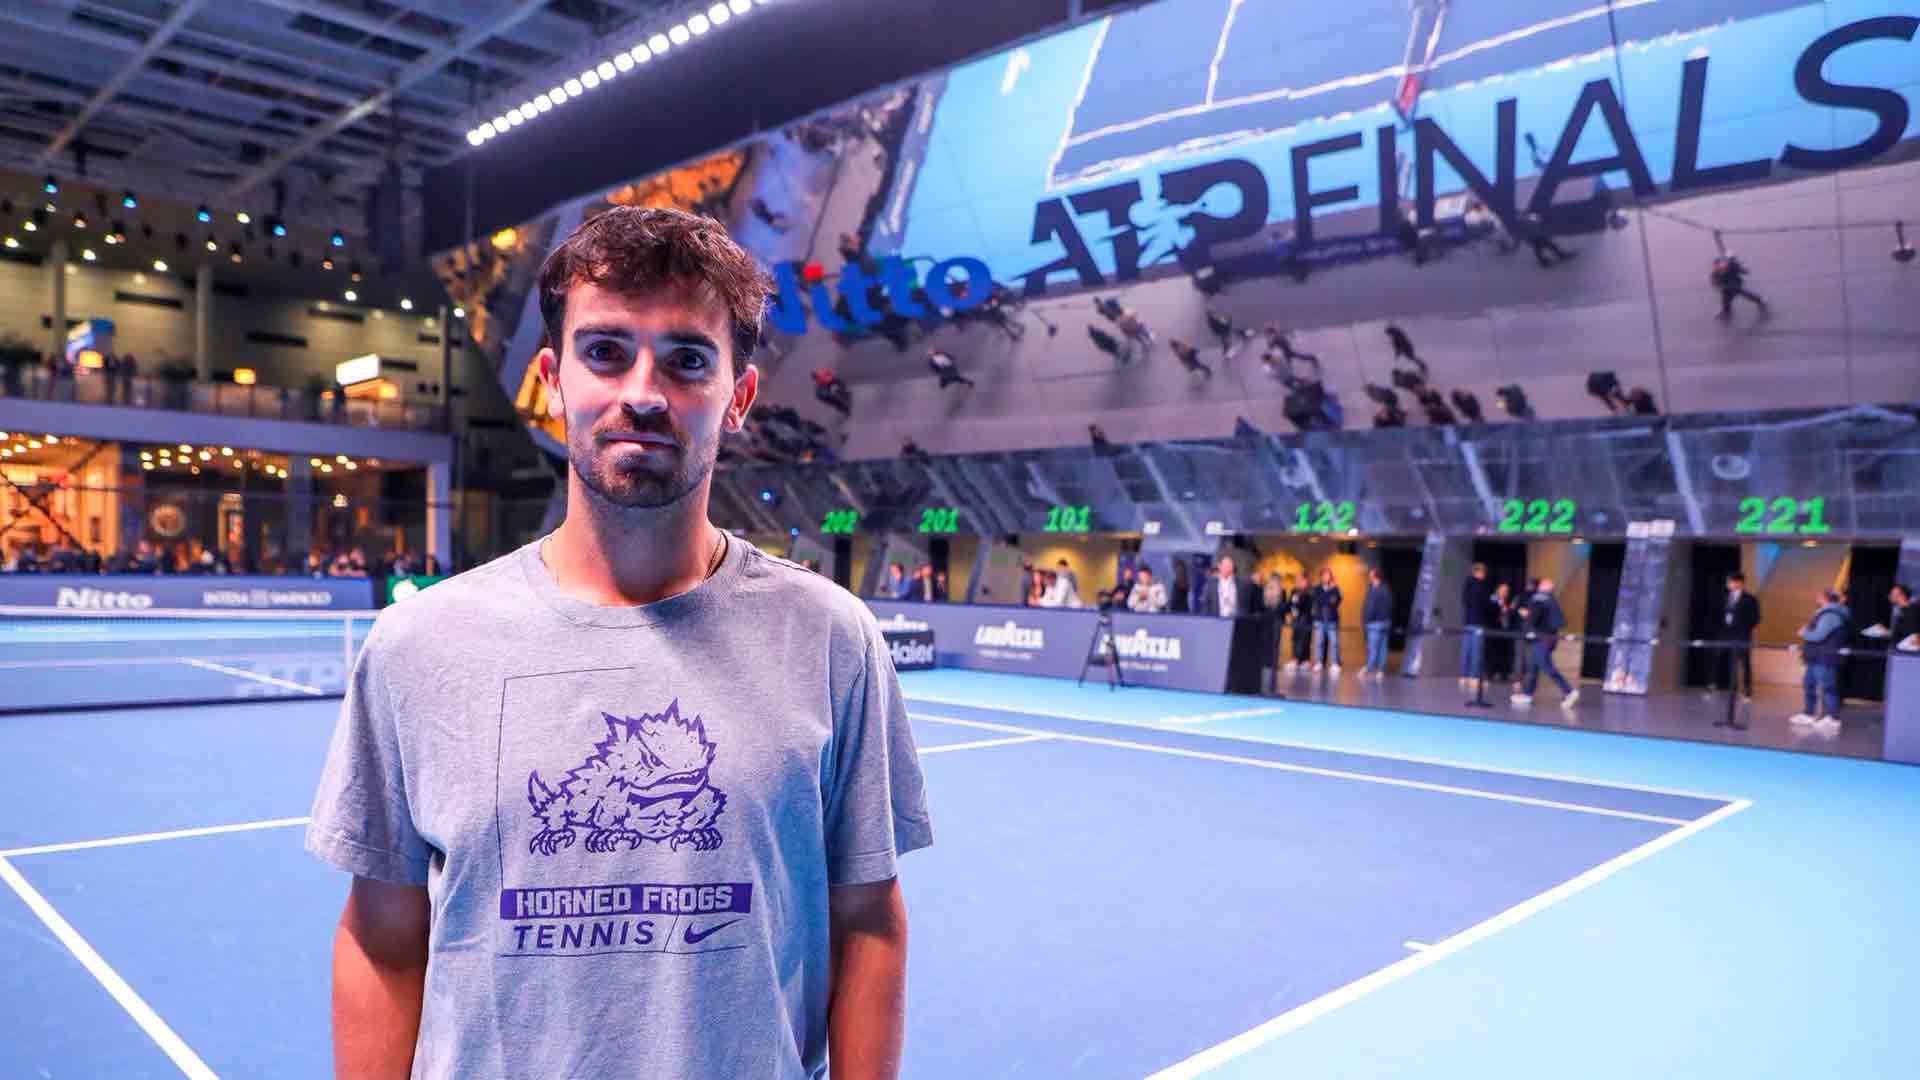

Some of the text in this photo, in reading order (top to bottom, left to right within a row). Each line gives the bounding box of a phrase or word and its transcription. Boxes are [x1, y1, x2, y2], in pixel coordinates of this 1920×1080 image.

[1006, 158, 1269, 296] ATP
[1290, 15, 1920, 252] FINALS
[821, 511, 859, 534] 202
[920, 508, 960, 533] 201
[1044, 506, 1091, 532] 101
[1293, 502, 1355, 532] 122
[1500, 500, 1576, 532] 222
[1736, 497, 1830, 533] 221
[56, 587, 153, 608] Nitto
[515, 885, 733, 918] HORNED FROGS
[513, 920, 654, 950] TENNIS
